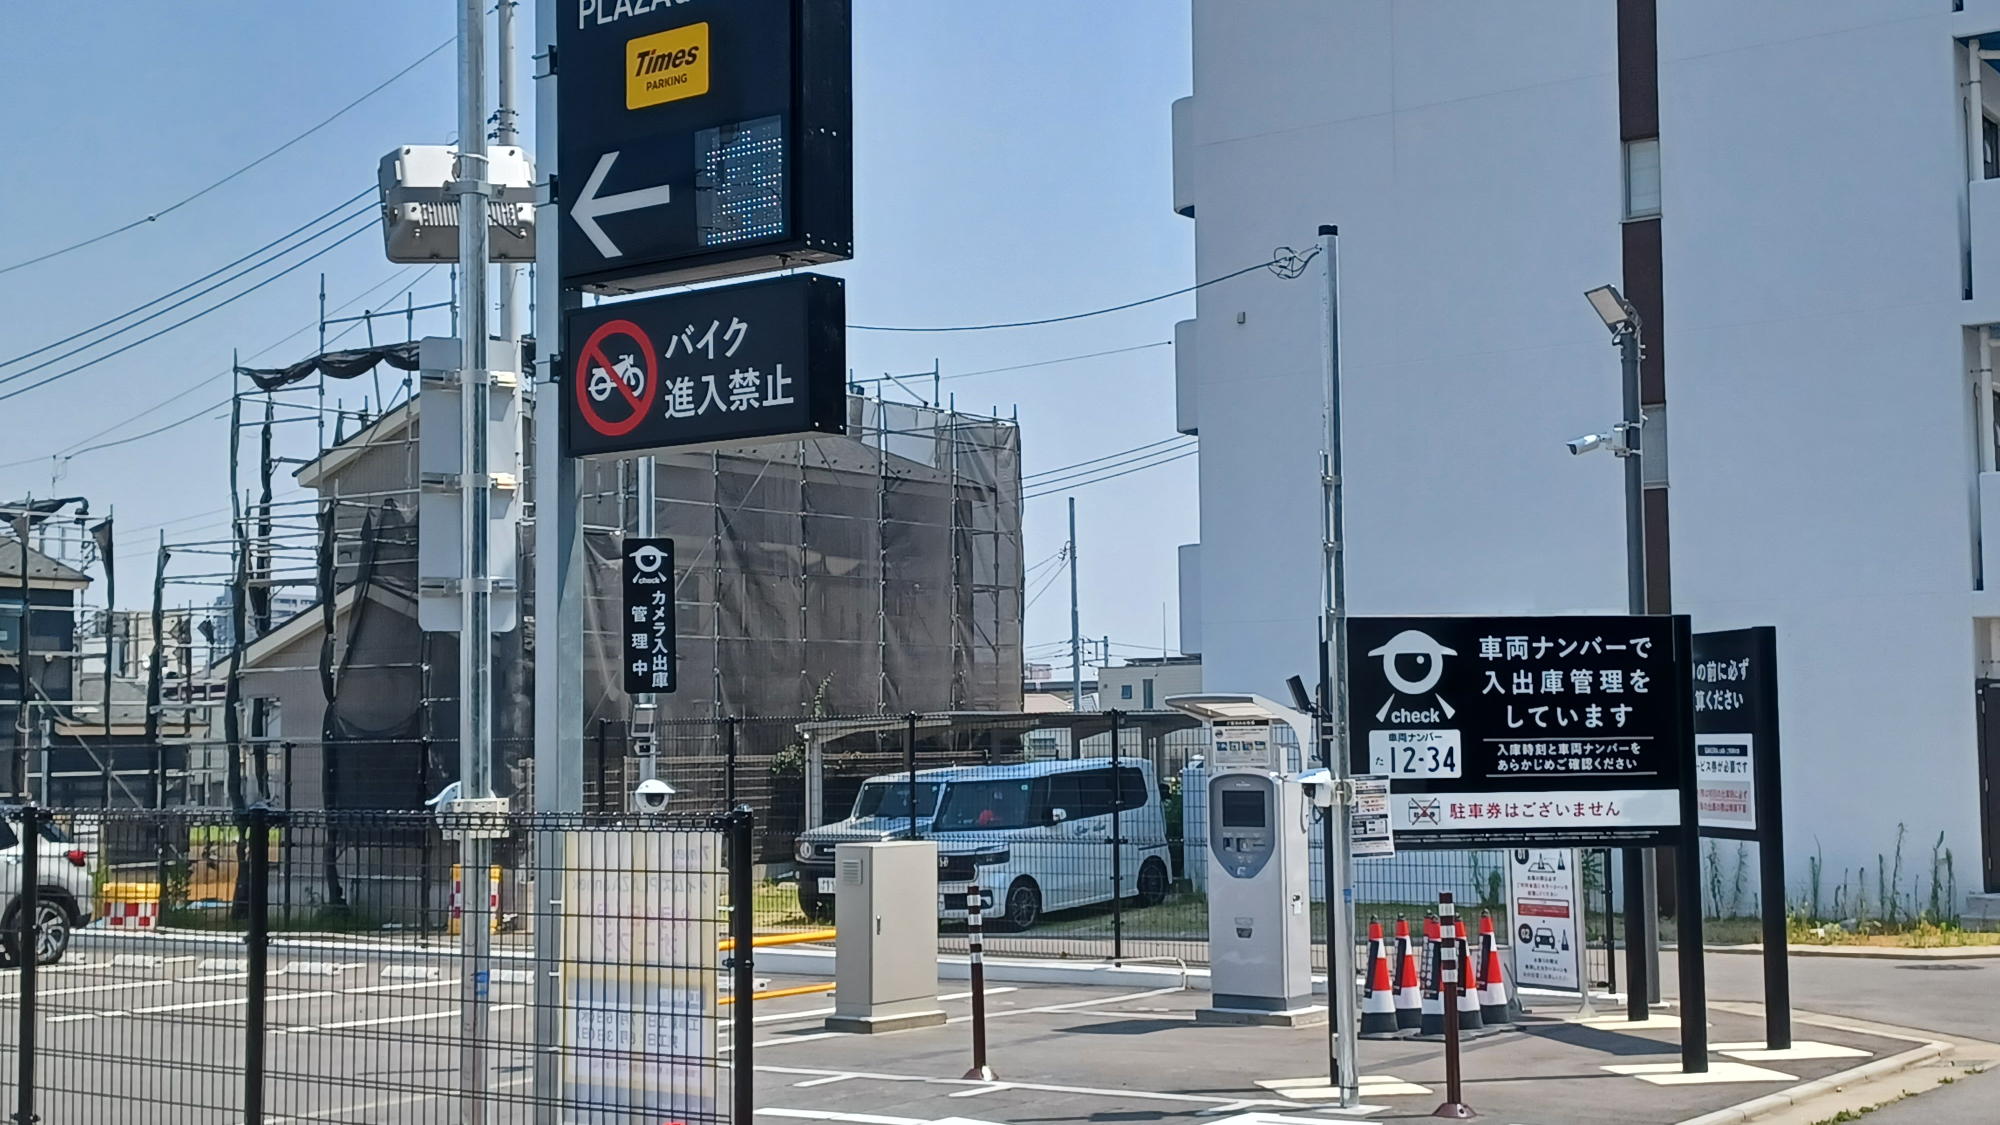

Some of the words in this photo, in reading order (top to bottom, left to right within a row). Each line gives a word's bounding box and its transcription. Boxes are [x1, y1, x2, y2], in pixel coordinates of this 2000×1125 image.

[635, 45, 699, 77] Times
[646, 74, 687, 91] PARKING
[664, 317, 748, 360] バイク
[664, 364, 794, 419] 進入禁止
[631, 606, 649, 677] 管理中
[651, 590, 669, 688] カメラ入出庫
[1479, 635, 1652, 661] 車両ナンバーで
[1482, 669, 1650, 695] 入出庫管理を
[1391, 706, 1440, 724] check
[1507, 703, 1633, 728] しています
[1389, 733, 1442, 742] 車両ナンバー
[1497, 742, 1640, 756] 入庫時刻と車両ナンバーを
[1497, 758, 1637, 771] あらかじめご確認ください
[1450, 801, 1620, 819] 駐車券はございません
